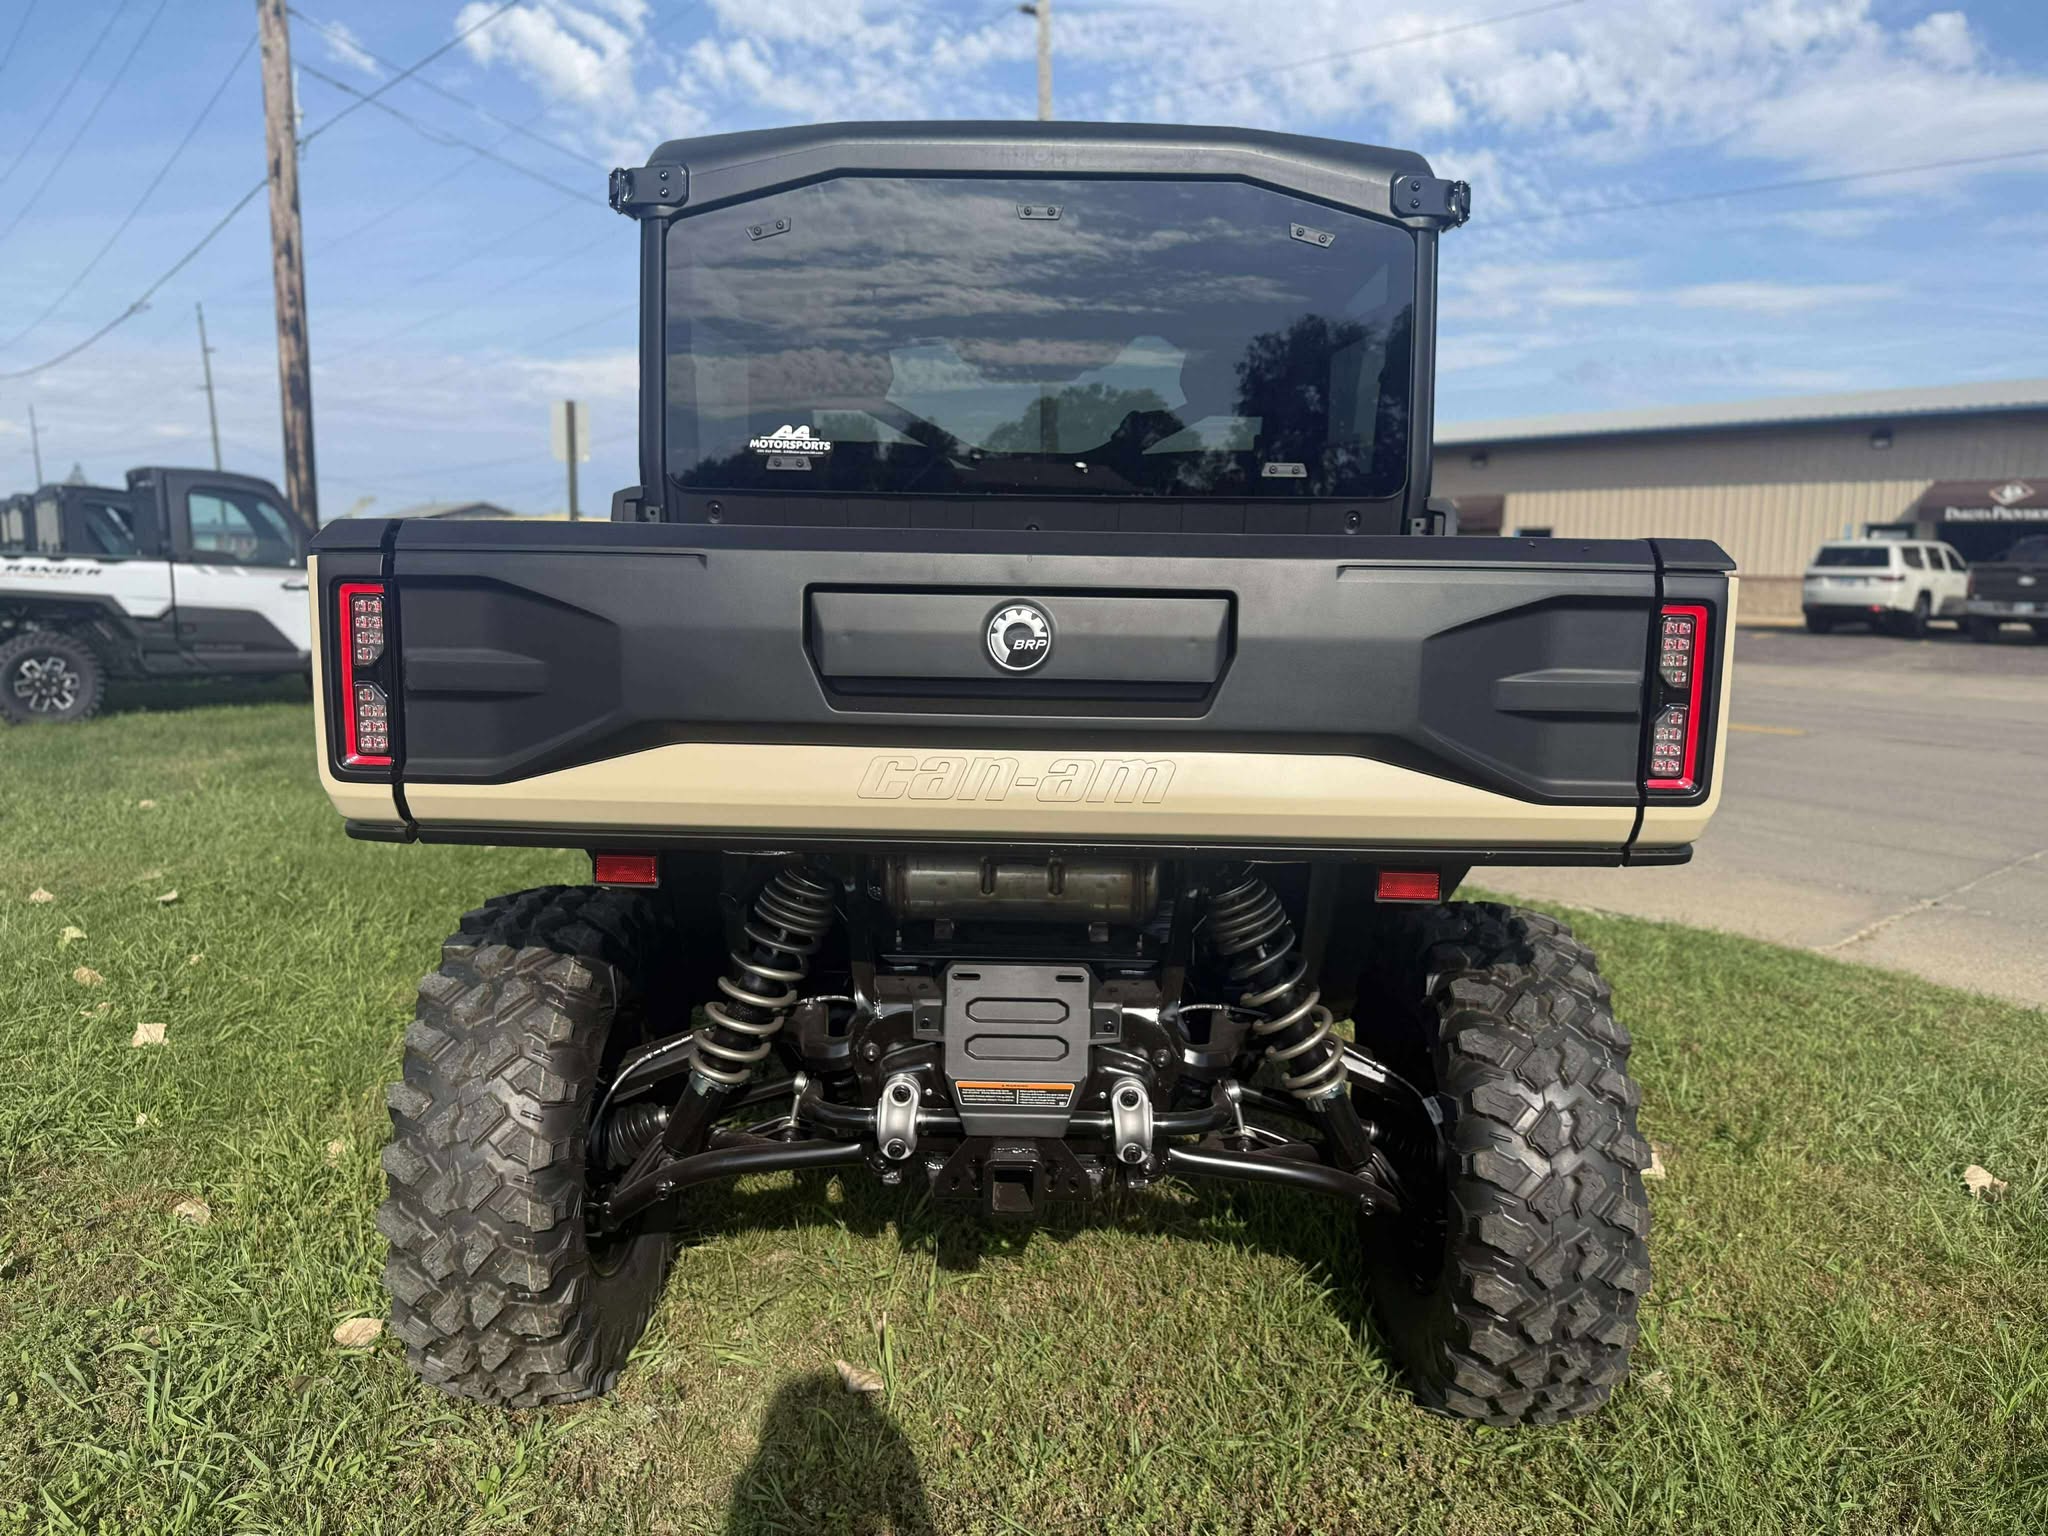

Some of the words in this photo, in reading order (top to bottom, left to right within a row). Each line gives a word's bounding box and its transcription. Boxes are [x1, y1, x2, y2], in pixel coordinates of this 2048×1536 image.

[749, 439, 831, 451] MOTORSPORTS
[1013, 639, 1048, 650] BRP
[856, 755, 1177, 804] can-am
